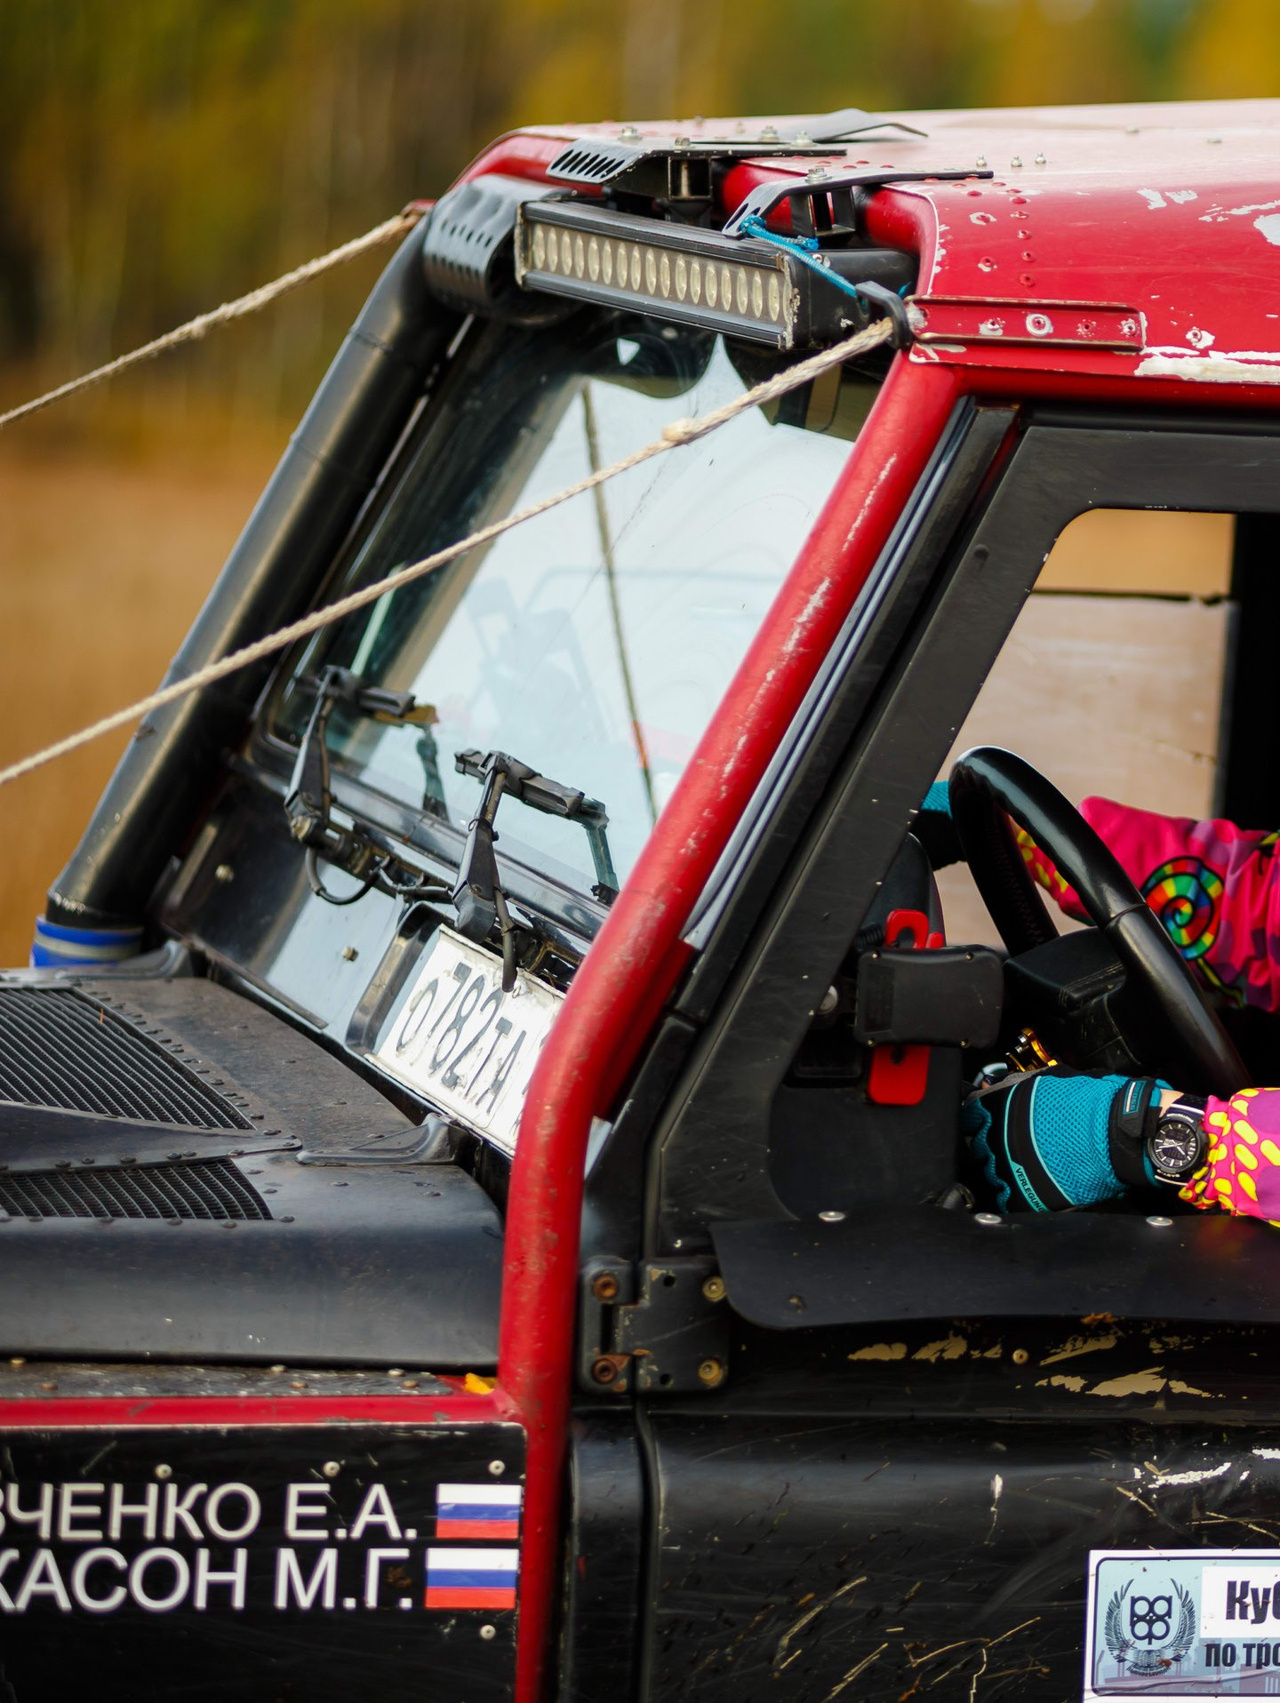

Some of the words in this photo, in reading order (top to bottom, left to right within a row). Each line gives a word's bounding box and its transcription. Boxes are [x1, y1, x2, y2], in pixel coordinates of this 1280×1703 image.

[0, 1482, 261, 1541] ЧЕНКО
[285, 1482, 418, 1540] Е.А.
[274, 1547, 413, 1610] М.Г.
[1205, 1642, 1236, 1669] по
